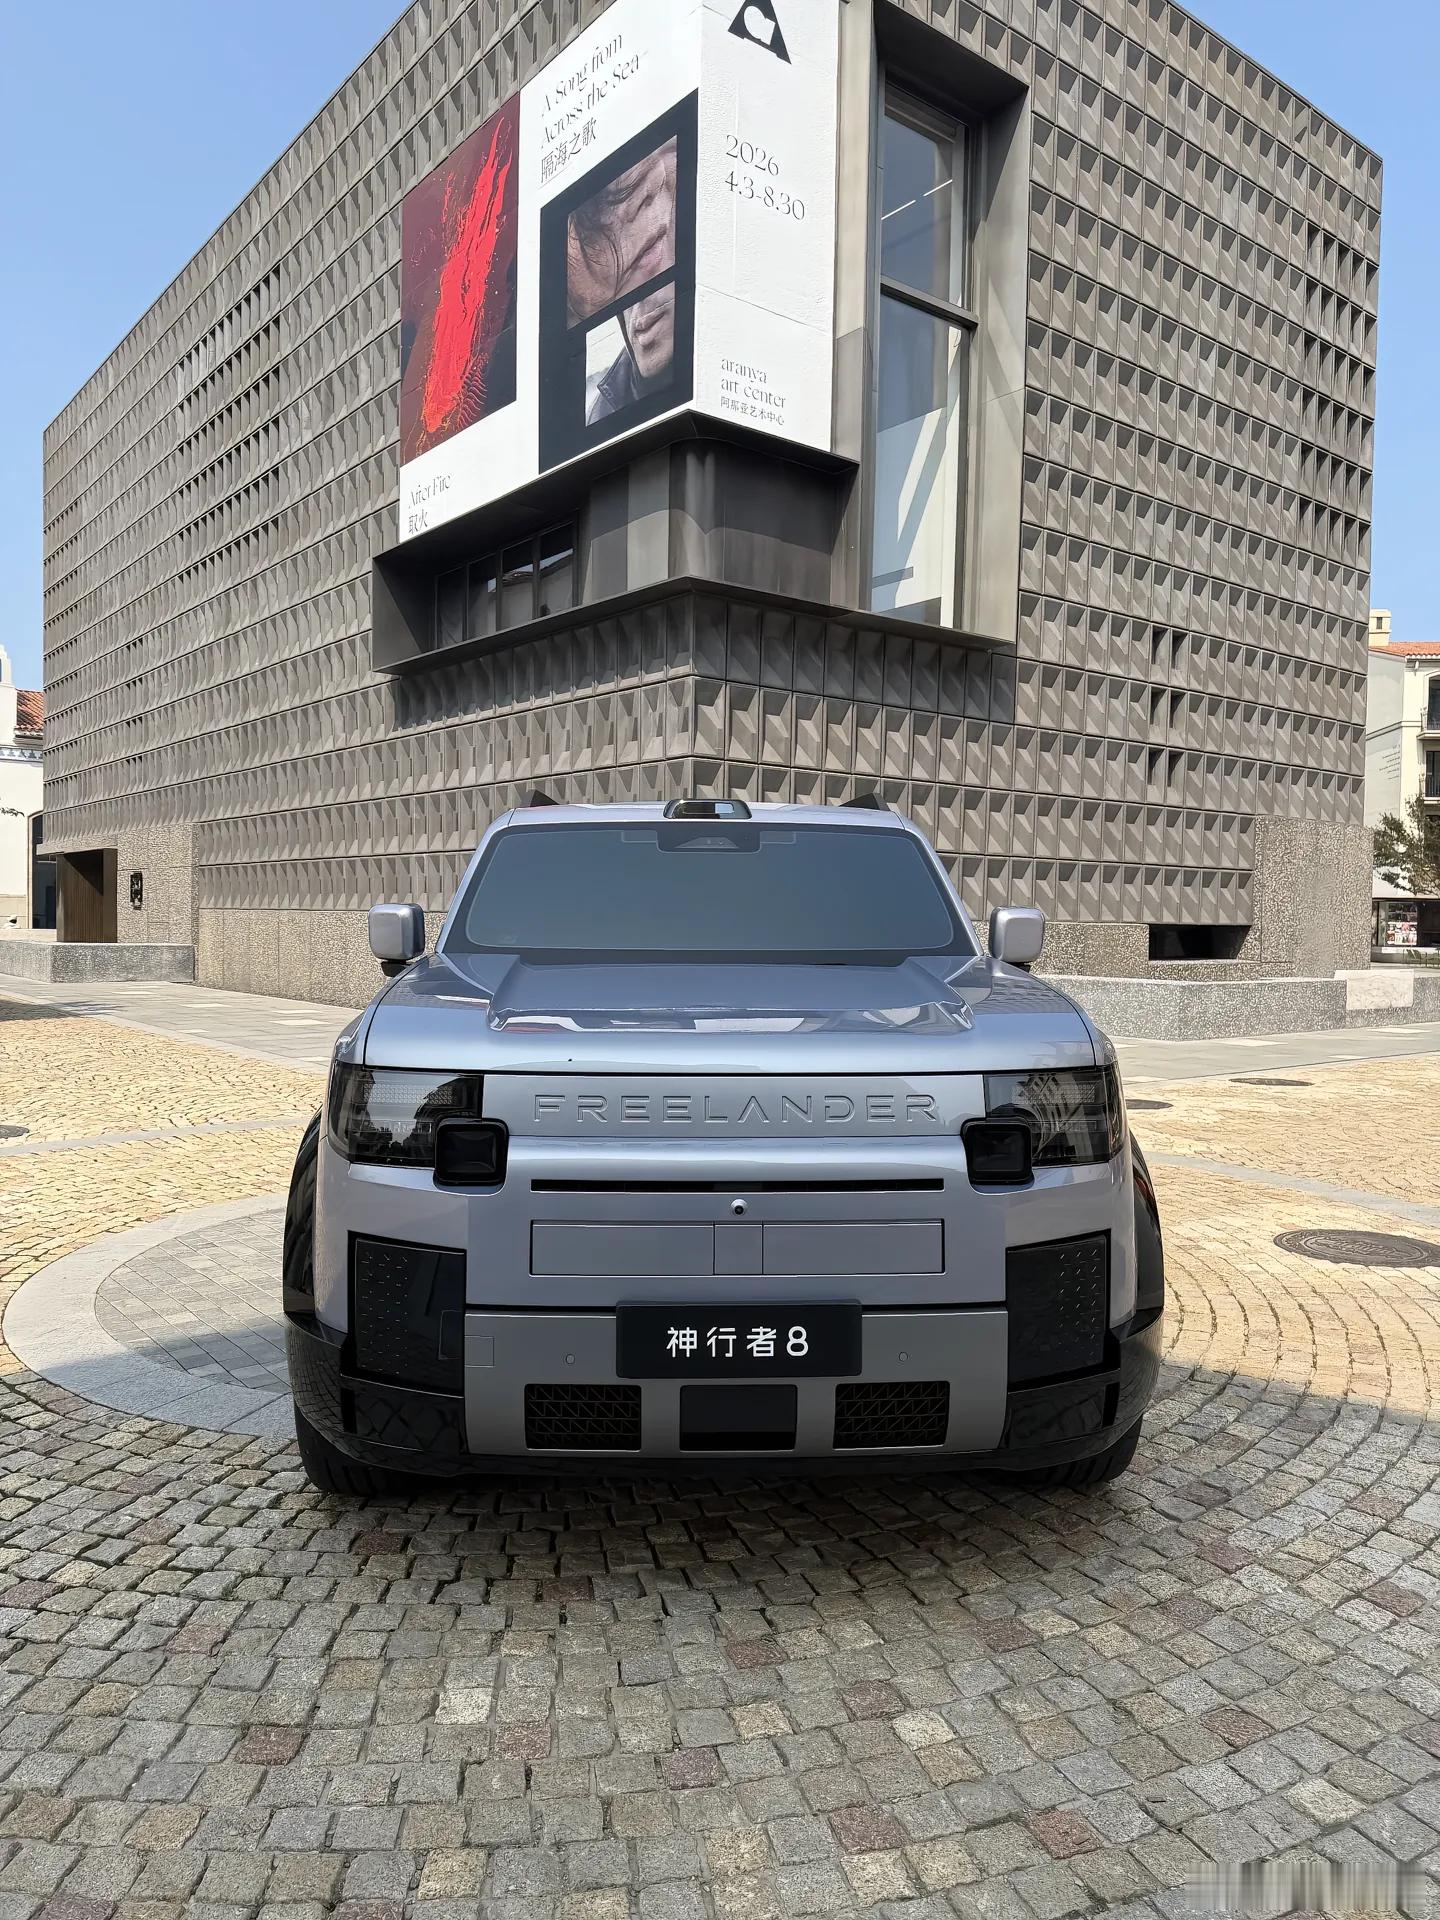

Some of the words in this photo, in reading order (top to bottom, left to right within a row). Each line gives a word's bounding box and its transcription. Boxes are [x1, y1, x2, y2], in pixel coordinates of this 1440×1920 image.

[555, 62, 588, 104] Song
[592, 34, 622, 73] from
[587, 80, 608, 110] the
[612, 53, 640, 88] Sea
[541, 116, 597, 184] 隔海之歌
[726, 134, 779, 176] 2026
[724, 170, 805, 221] 4.3-8.30
[721, 359, 767, 384] aranya
[721, 378, 739, 394] art
[743, 385, 786, 409] center
[720, 396, 785, 426] 阿那亚艺术中心
[408, 508, 428, 535] 取火
[533, 1093, 938, 1123] FREELANDER
[666, 1326, 810, 1358] 神行者8
